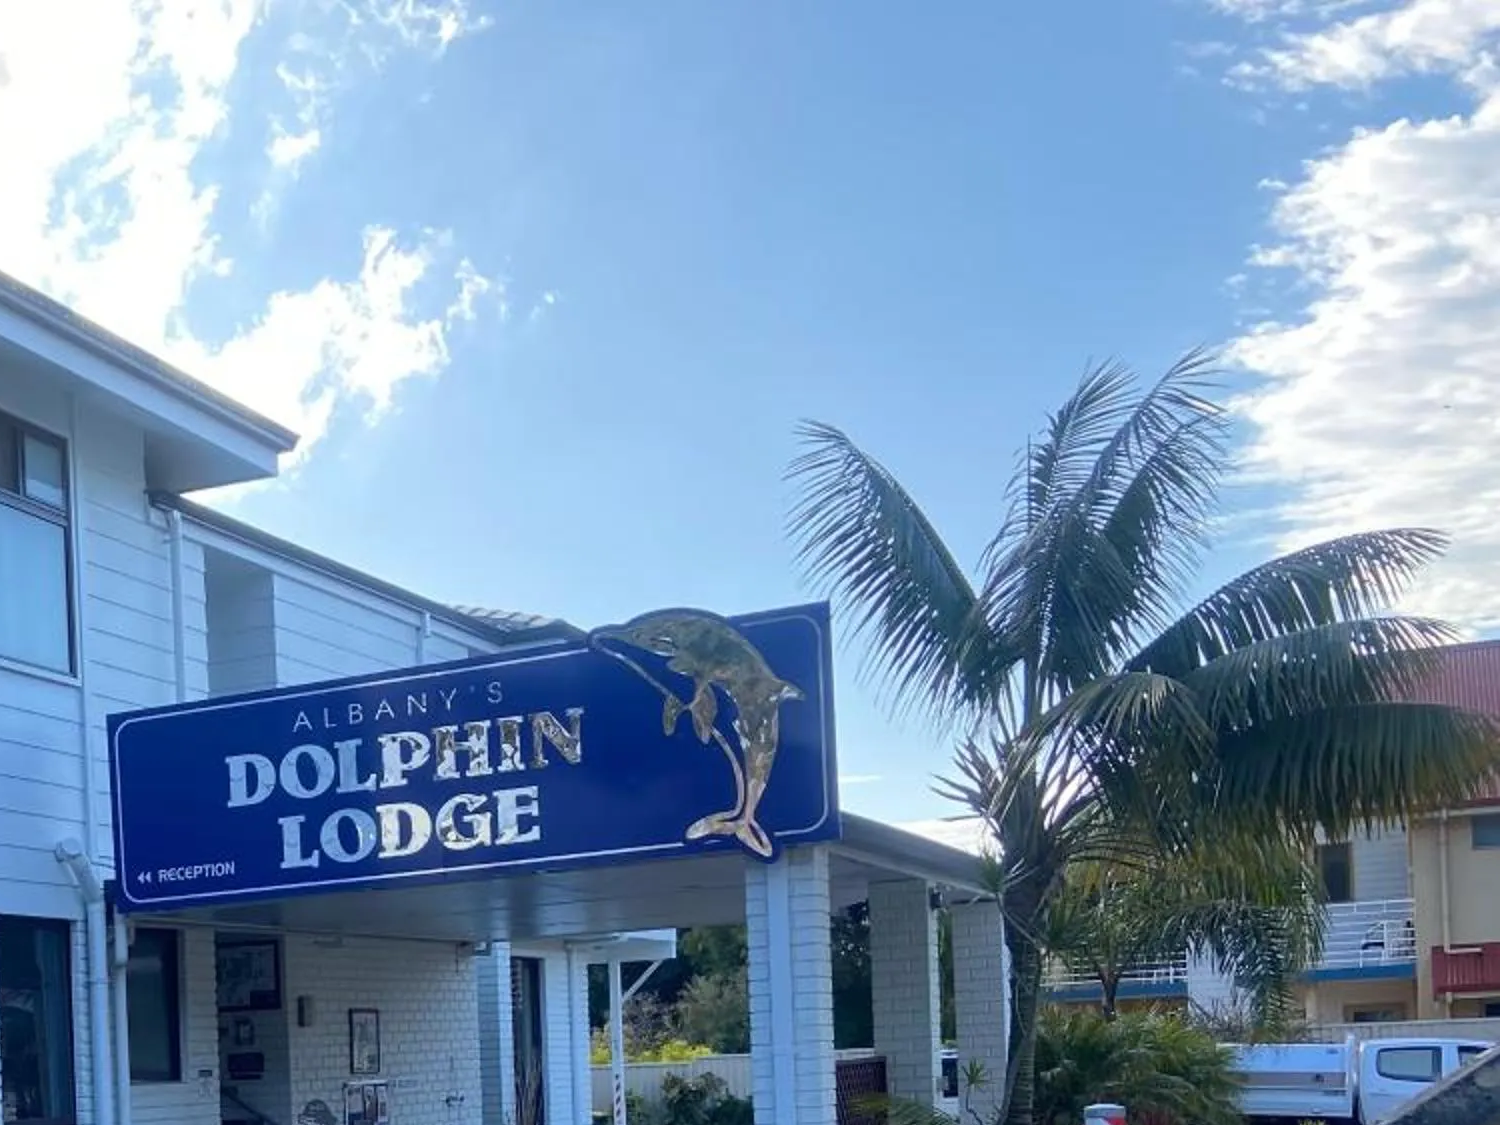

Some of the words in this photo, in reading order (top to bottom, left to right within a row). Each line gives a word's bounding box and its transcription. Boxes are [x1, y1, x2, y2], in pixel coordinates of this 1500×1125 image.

[293, 681, 503, 732] ALBANY'S
[225, 707, 584, 808] DOLPHIN
[278, 785, 540, 869] LODGE
[158, 860, 235, 884] RECEPTION
